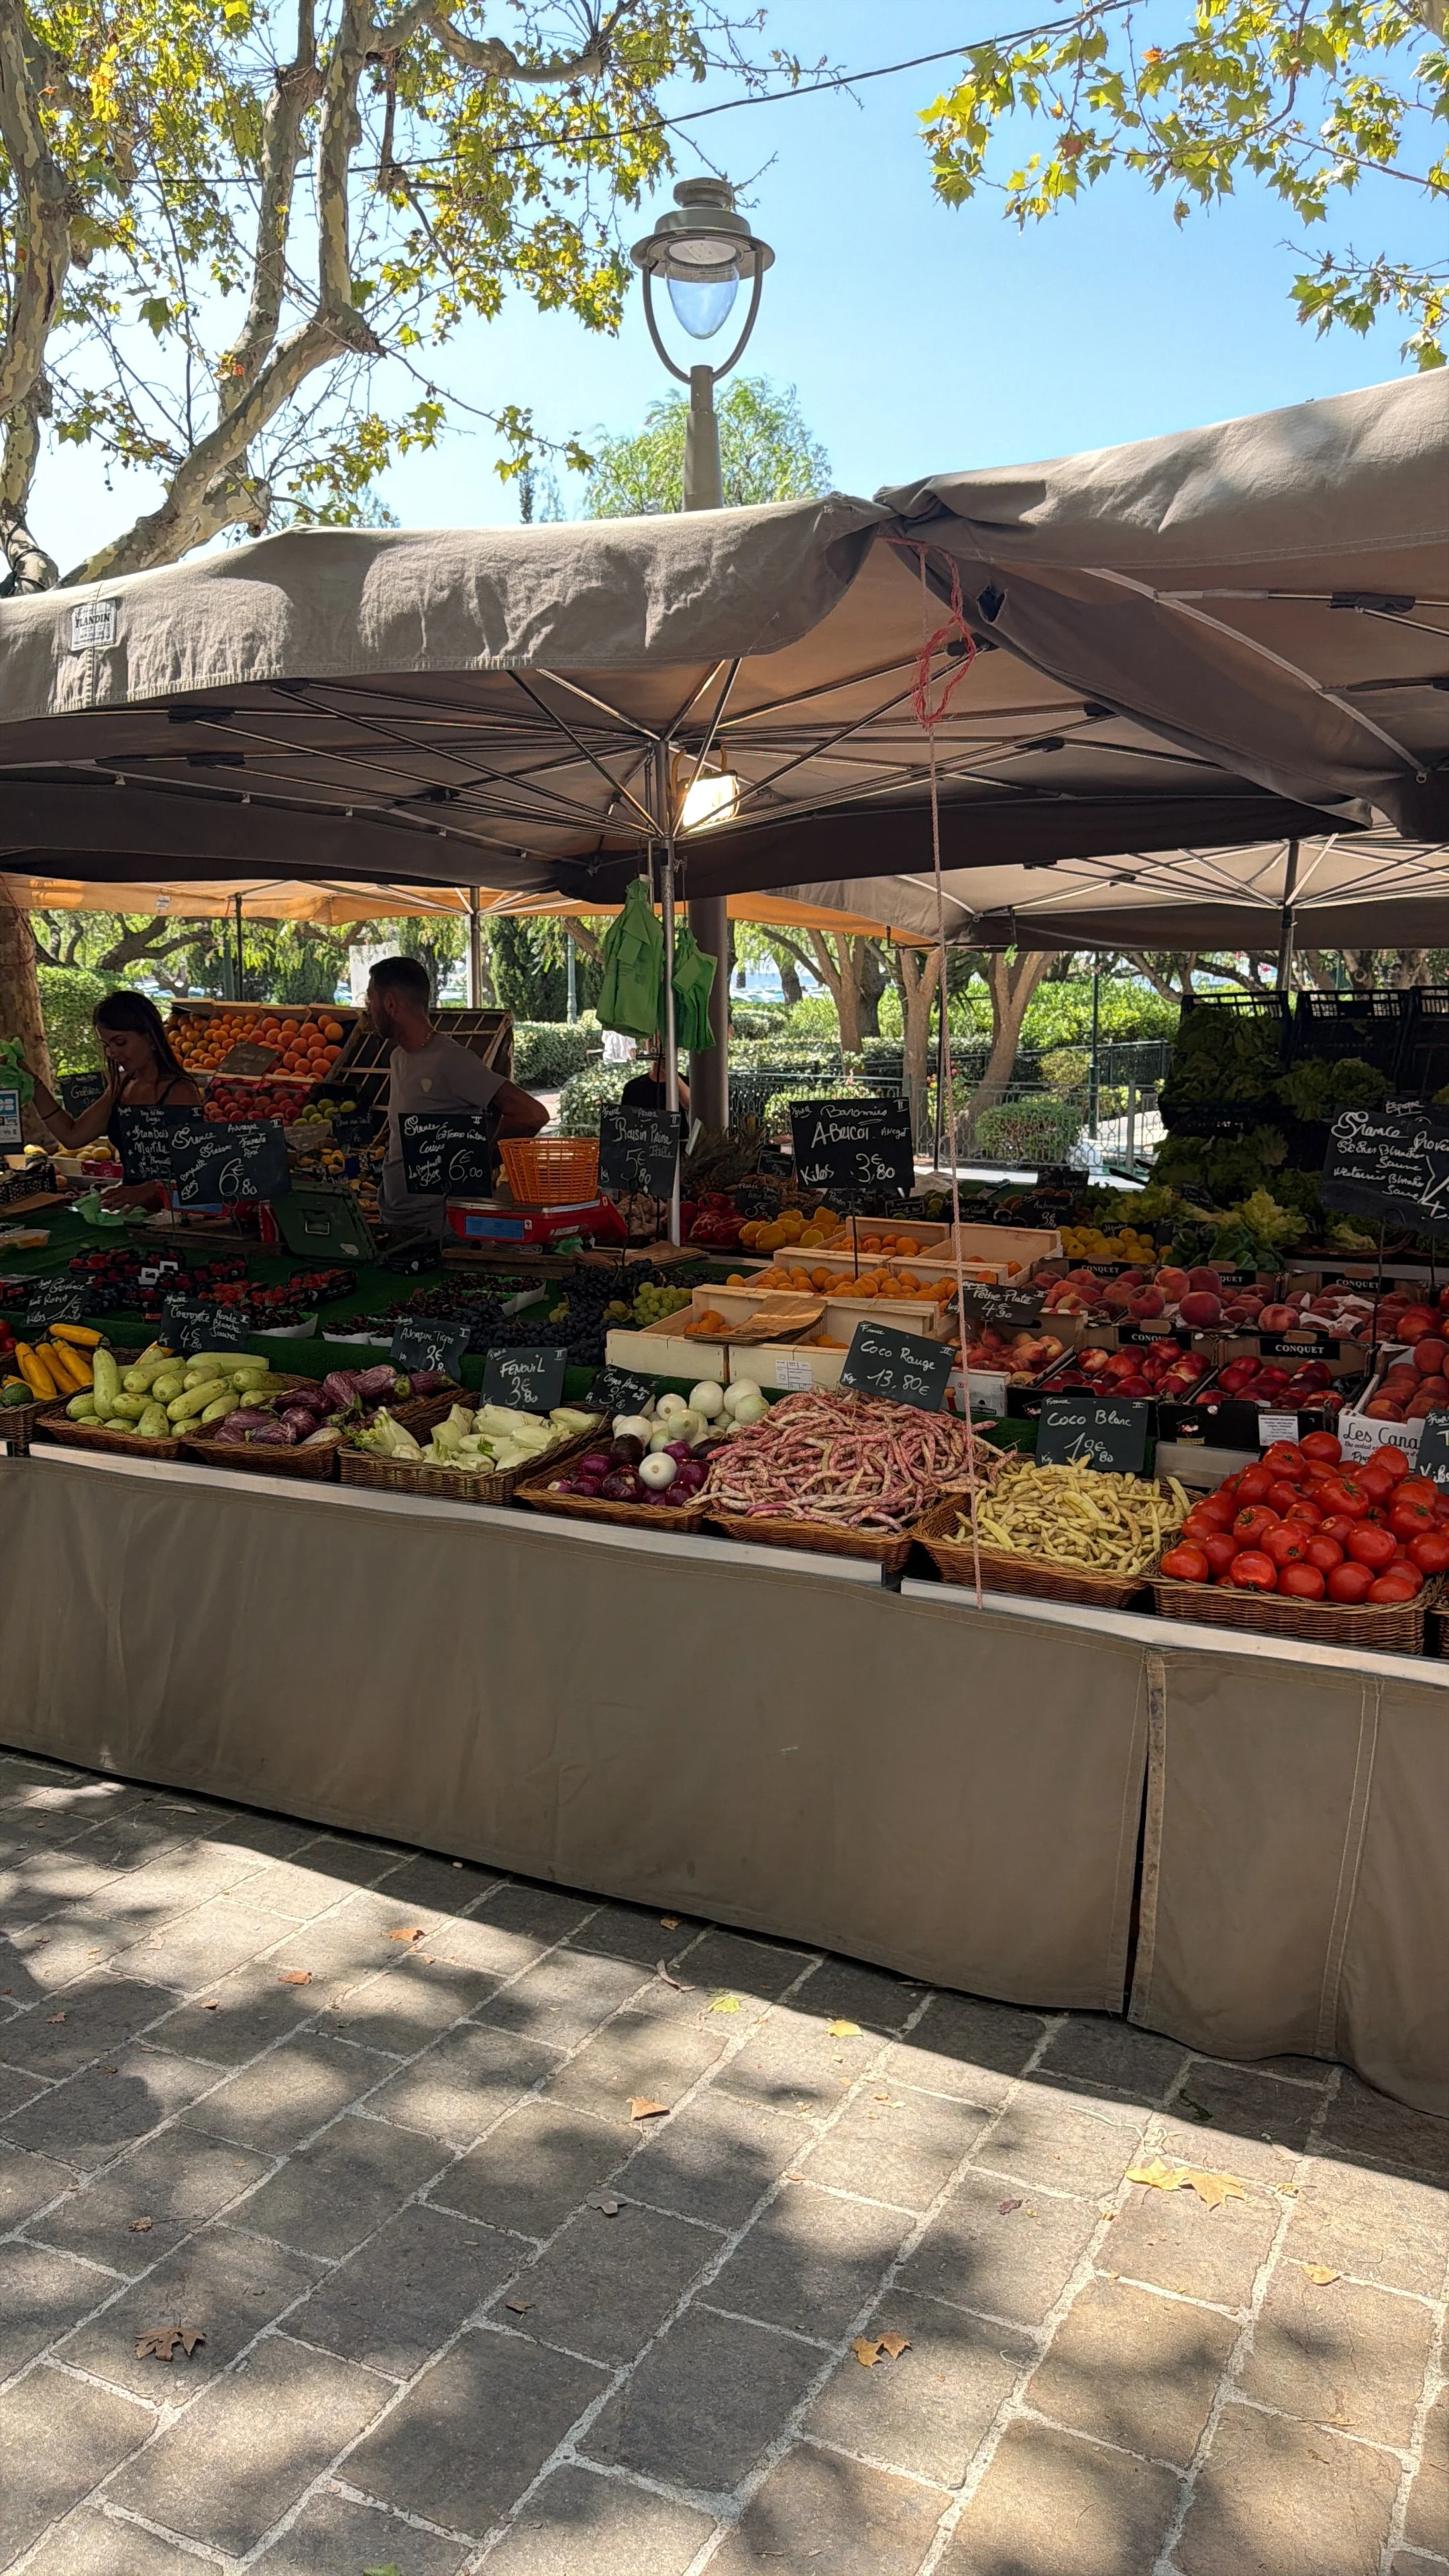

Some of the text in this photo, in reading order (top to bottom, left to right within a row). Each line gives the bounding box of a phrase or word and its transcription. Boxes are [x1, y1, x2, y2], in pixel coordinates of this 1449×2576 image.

[75, 613, 110, 628] FLANDIN
[892, 1099, 909, 1113] II
[612, 1116, 647, 1142] Raisin
[1330, 1110, 1409, 1140] France
[1081, 1265, 1120, 1274] CONQUET
[860, 1324, 885, 1335] France
[553, 1348, 568, 1361] II
[860, 1340, 893, 1357] Coco
[938, 1346, 956, 1356] II
[1275, 1344, 1325, 1354] CONQUET
[1045, 1397, 1071, 1406] France
[1046, 1409, 1132, 1427] Coco Blanc
[1343, 1421, 1373, 1442] Les
